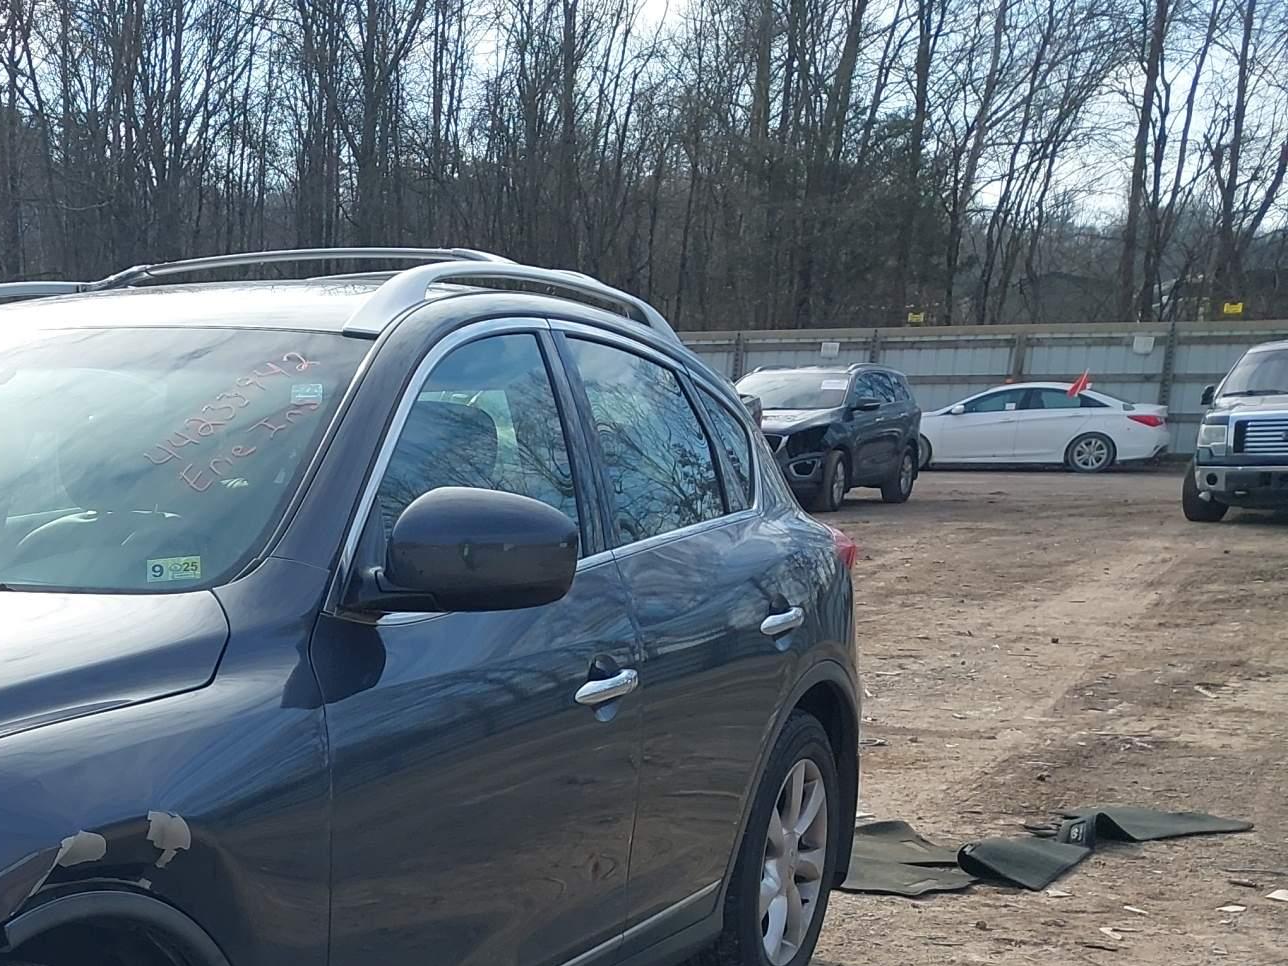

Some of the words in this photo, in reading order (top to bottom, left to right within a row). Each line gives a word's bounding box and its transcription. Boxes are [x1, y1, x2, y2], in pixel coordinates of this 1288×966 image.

[144, 352, 321, 464] 44233942
[151, 563, 164, 578] 9
[182, 561, 199, 572] 25
